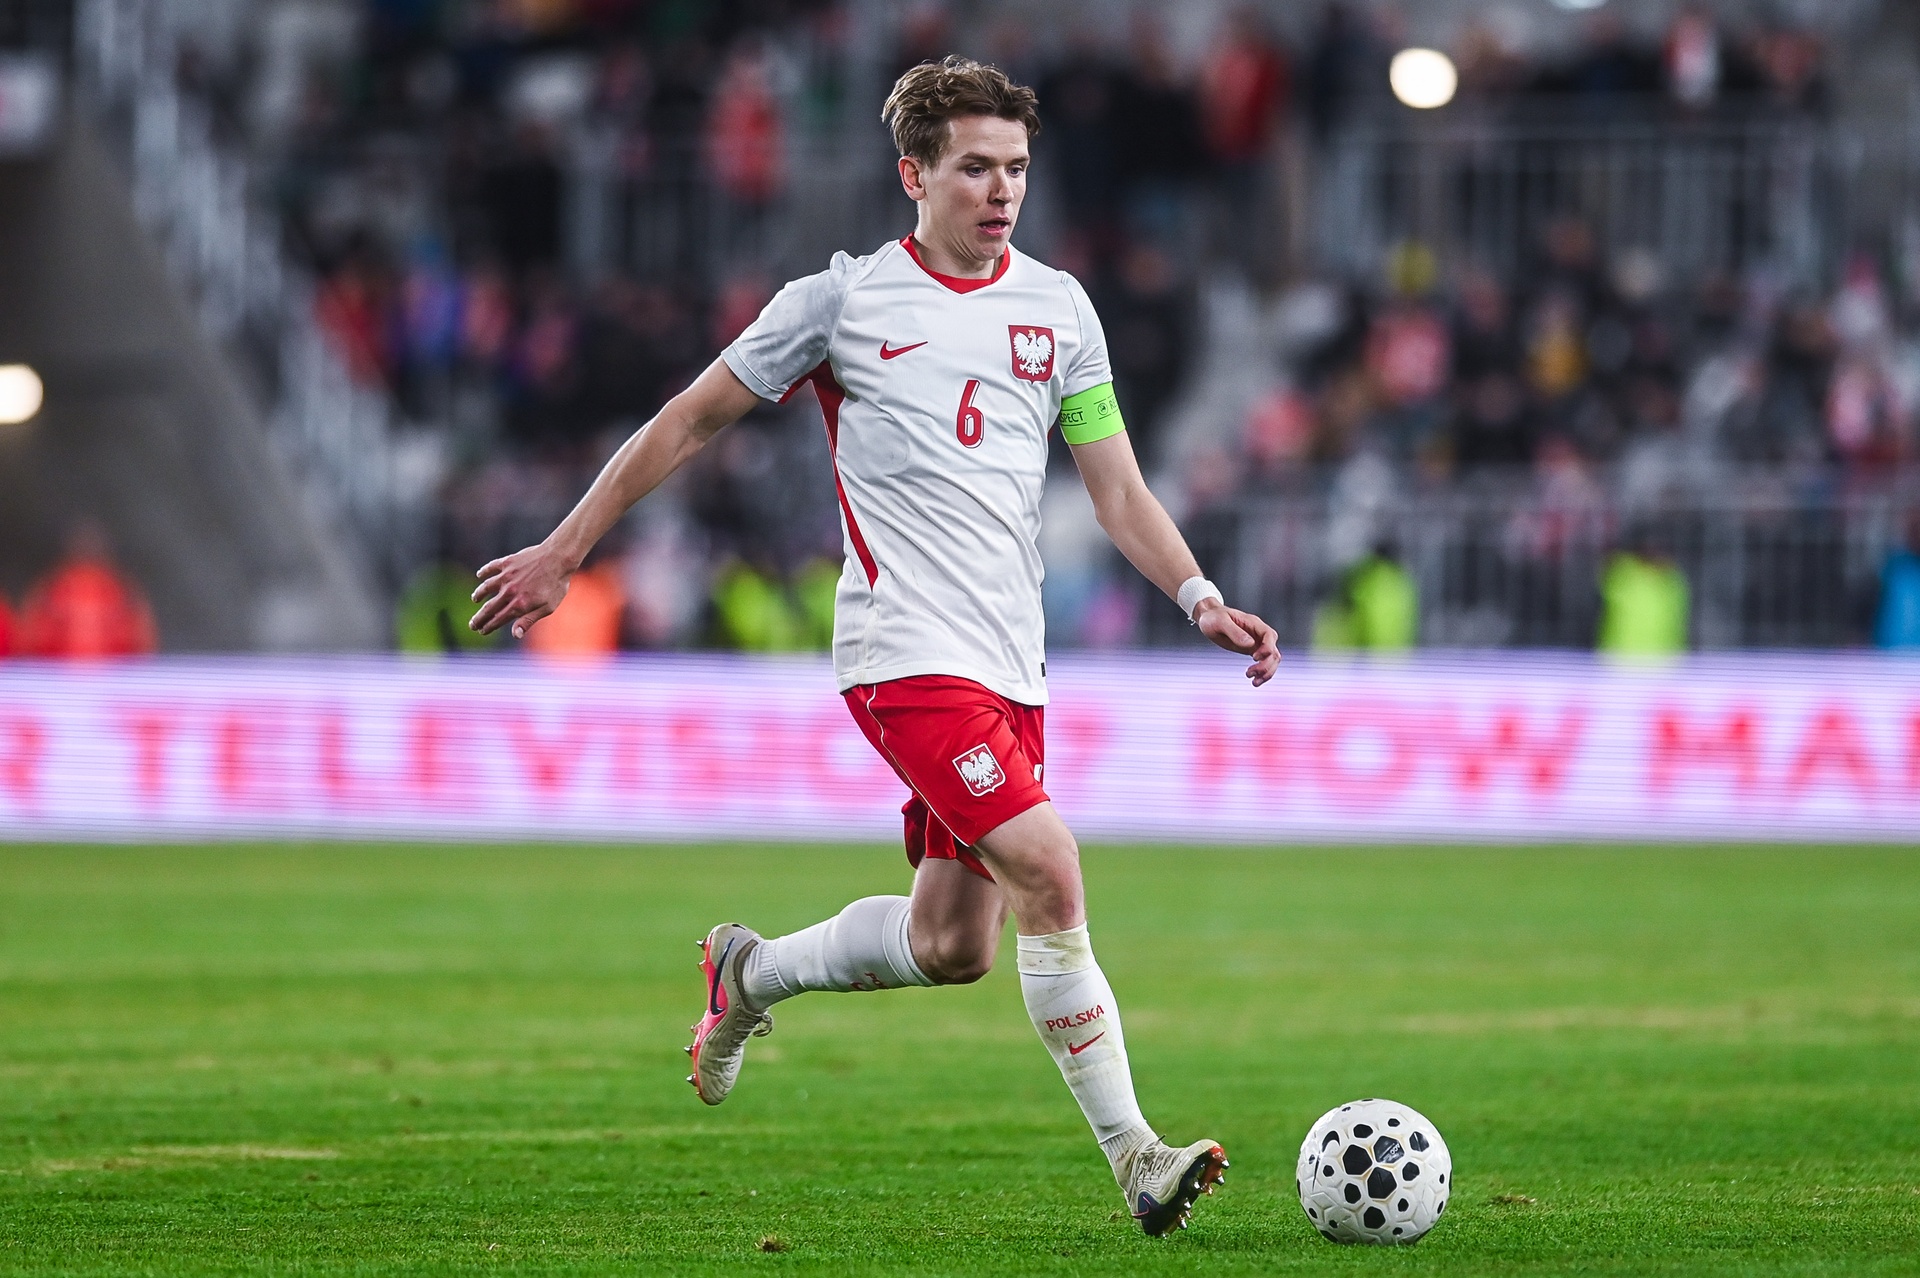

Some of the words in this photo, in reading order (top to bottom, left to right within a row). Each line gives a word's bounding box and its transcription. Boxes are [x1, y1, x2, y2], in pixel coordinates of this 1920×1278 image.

[957, 380, 984, 449] 6
[1187, 700, 1590, 804] HOW
[1640, 700, 1920, 801] MA
[1045, 1005, 1104, 1032] POLSKA
